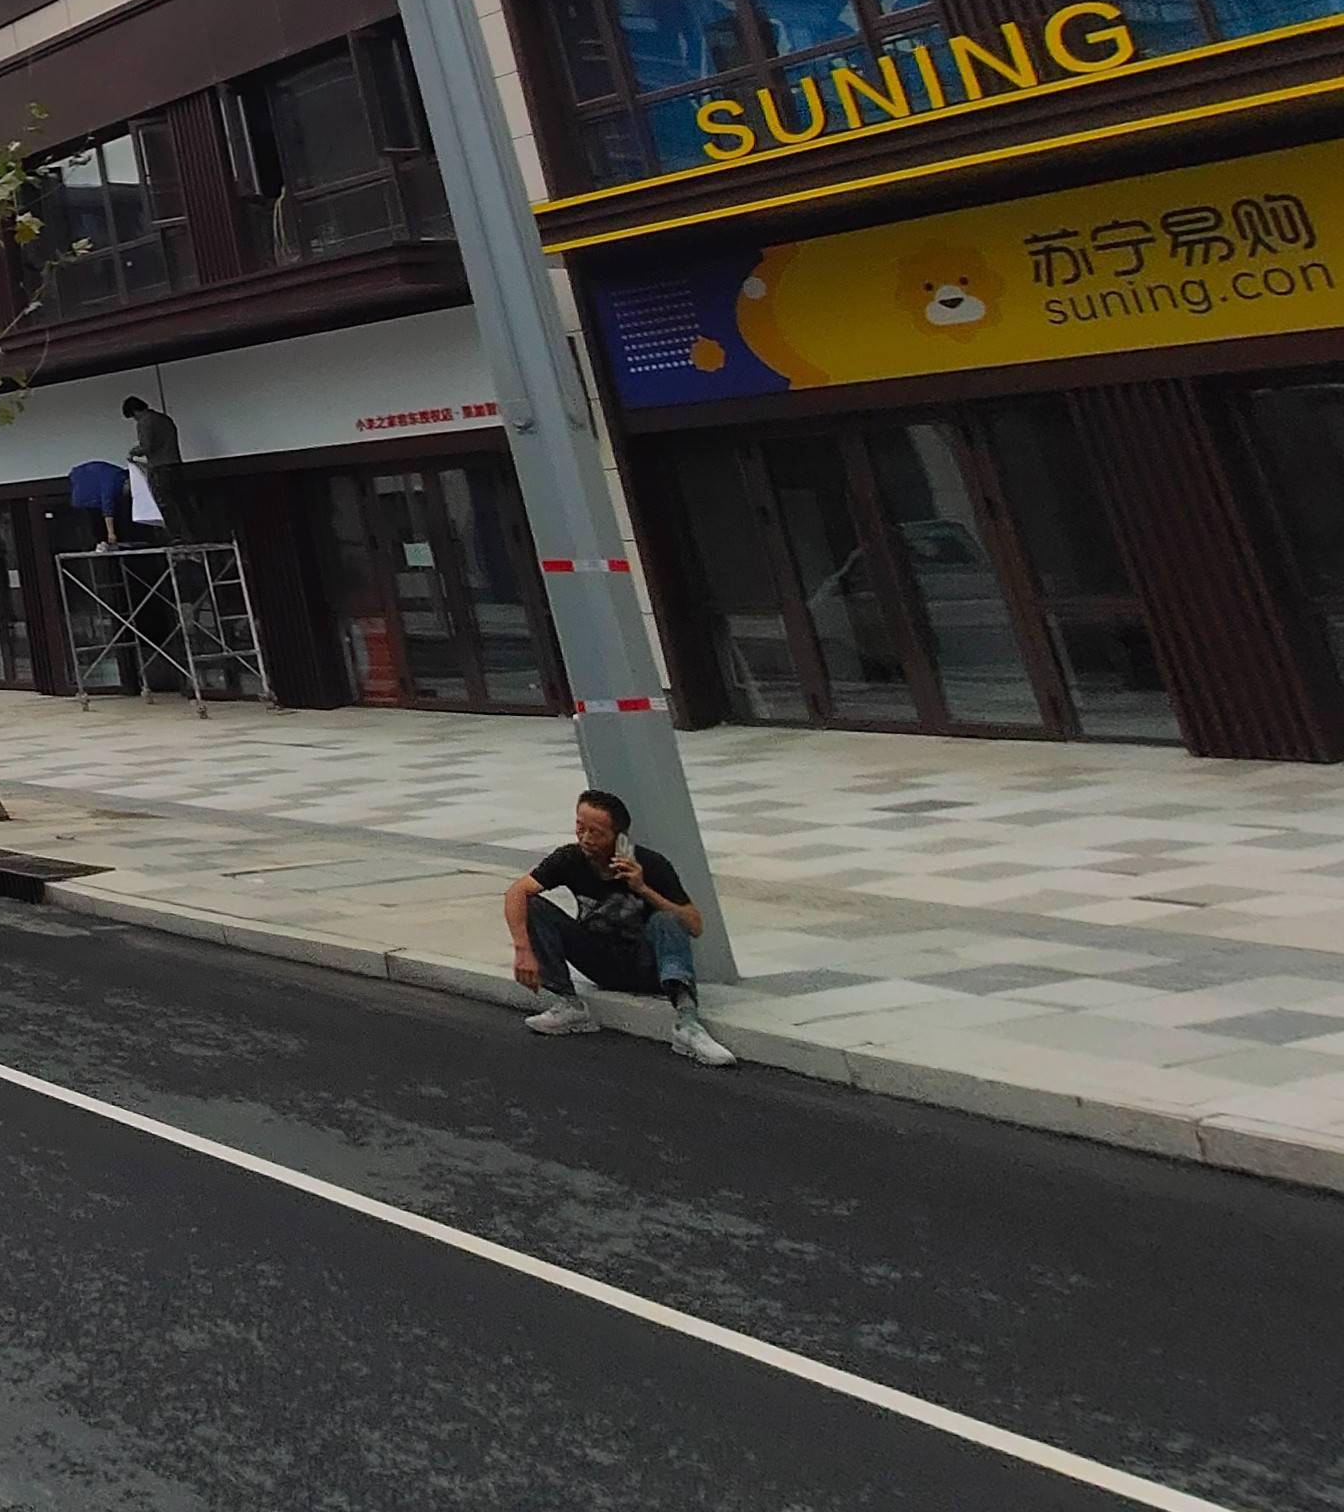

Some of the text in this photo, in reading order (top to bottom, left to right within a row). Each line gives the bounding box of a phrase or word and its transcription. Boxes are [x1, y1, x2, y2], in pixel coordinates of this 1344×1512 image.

[696, 1, 1136, 162] SUNING
[1024, 194, 1317, 288] 苏宁易购
